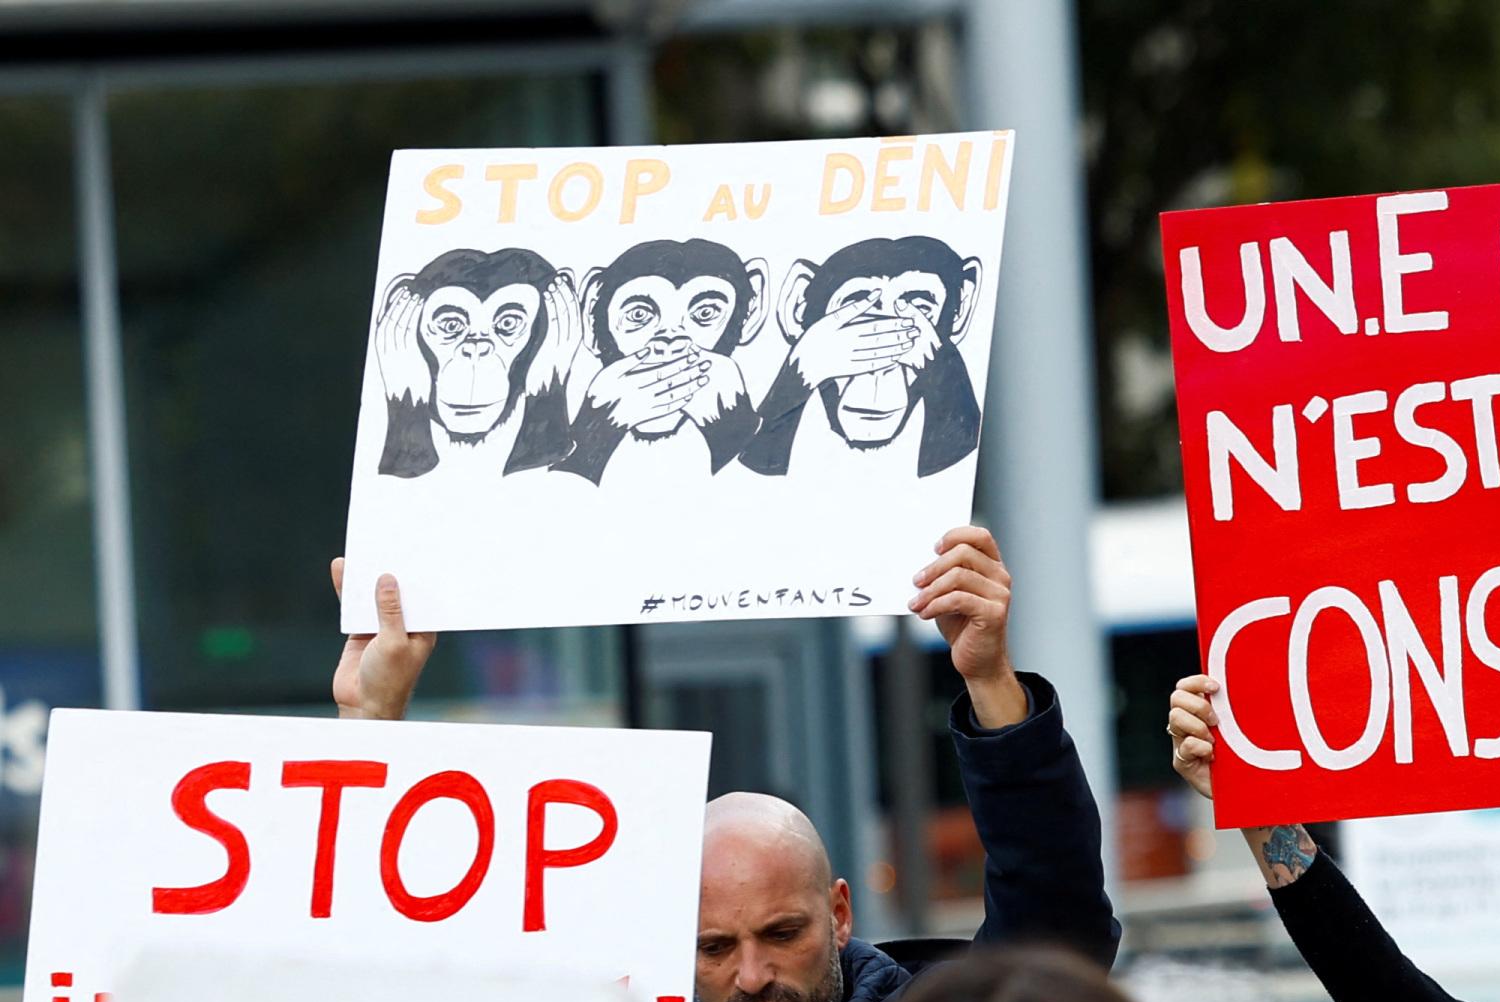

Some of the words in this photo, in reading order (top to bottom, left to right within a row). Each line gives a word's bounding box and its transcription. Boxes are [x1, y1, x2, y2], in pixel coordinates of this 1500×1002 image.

[415, 158, 671, 225] STOP
[703, 182, 771, 223] AU
[1179, 190, 1450, 354] UN.E
[639, 586, 873, 615] #MOUVENFANTS
[152, 760, 618, 932] STOP
